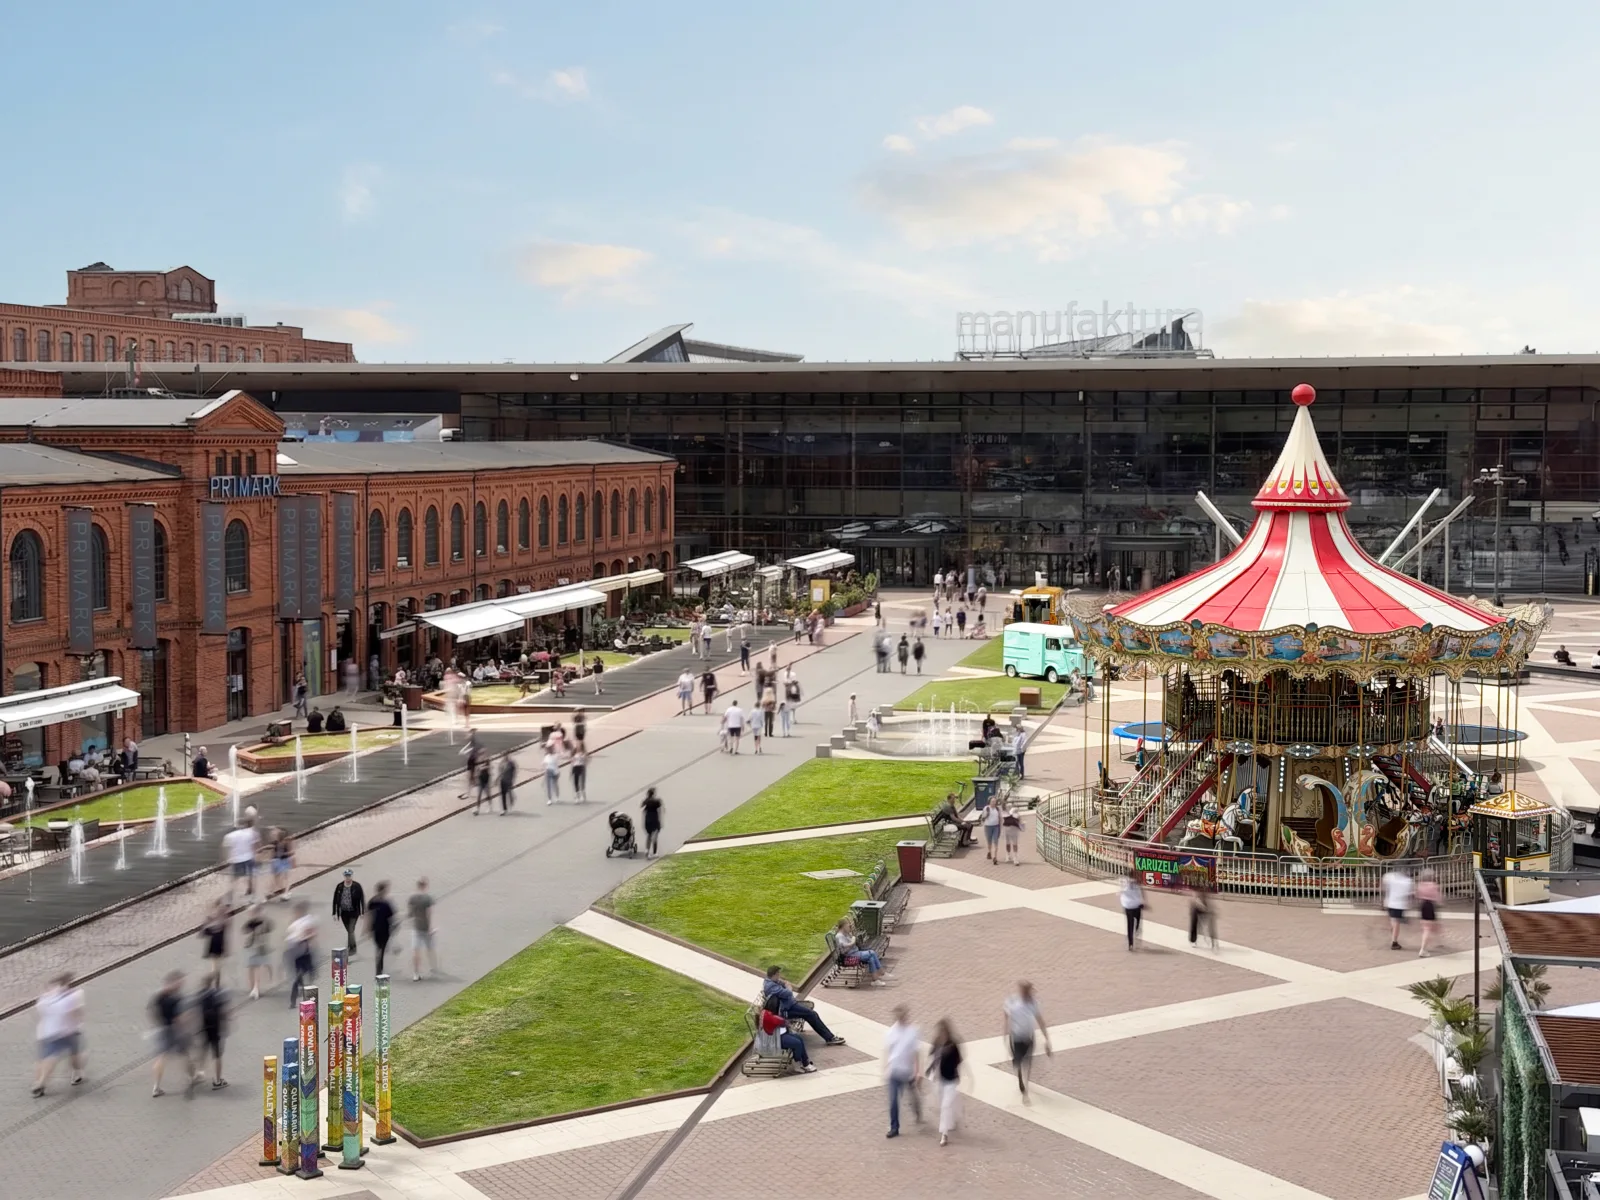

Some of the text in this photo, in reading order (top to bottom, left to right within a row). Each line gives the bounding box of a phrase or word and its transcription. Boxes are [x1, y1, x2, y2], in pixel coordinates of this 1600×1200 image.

[956, 300, 1204, 337] manufaktura
[210, 475, 281, 499] PRIMARK
[72, 521, 90, 638] PRIMARK
[135, 520, 153, 633] PRIMARK
[206, 513, 224, 621] PRIMARK
[282, 507, 298, 608] PRIMARK
[304, 507, 320, 605] PRIMARK
[338, 504, 352, 600] PRIMARK
[1135, 857, 1179, 874] KARUZELA
[1145, 872, 1155, 885] 5
[266, 1080, 274, 1118] TOALETY
